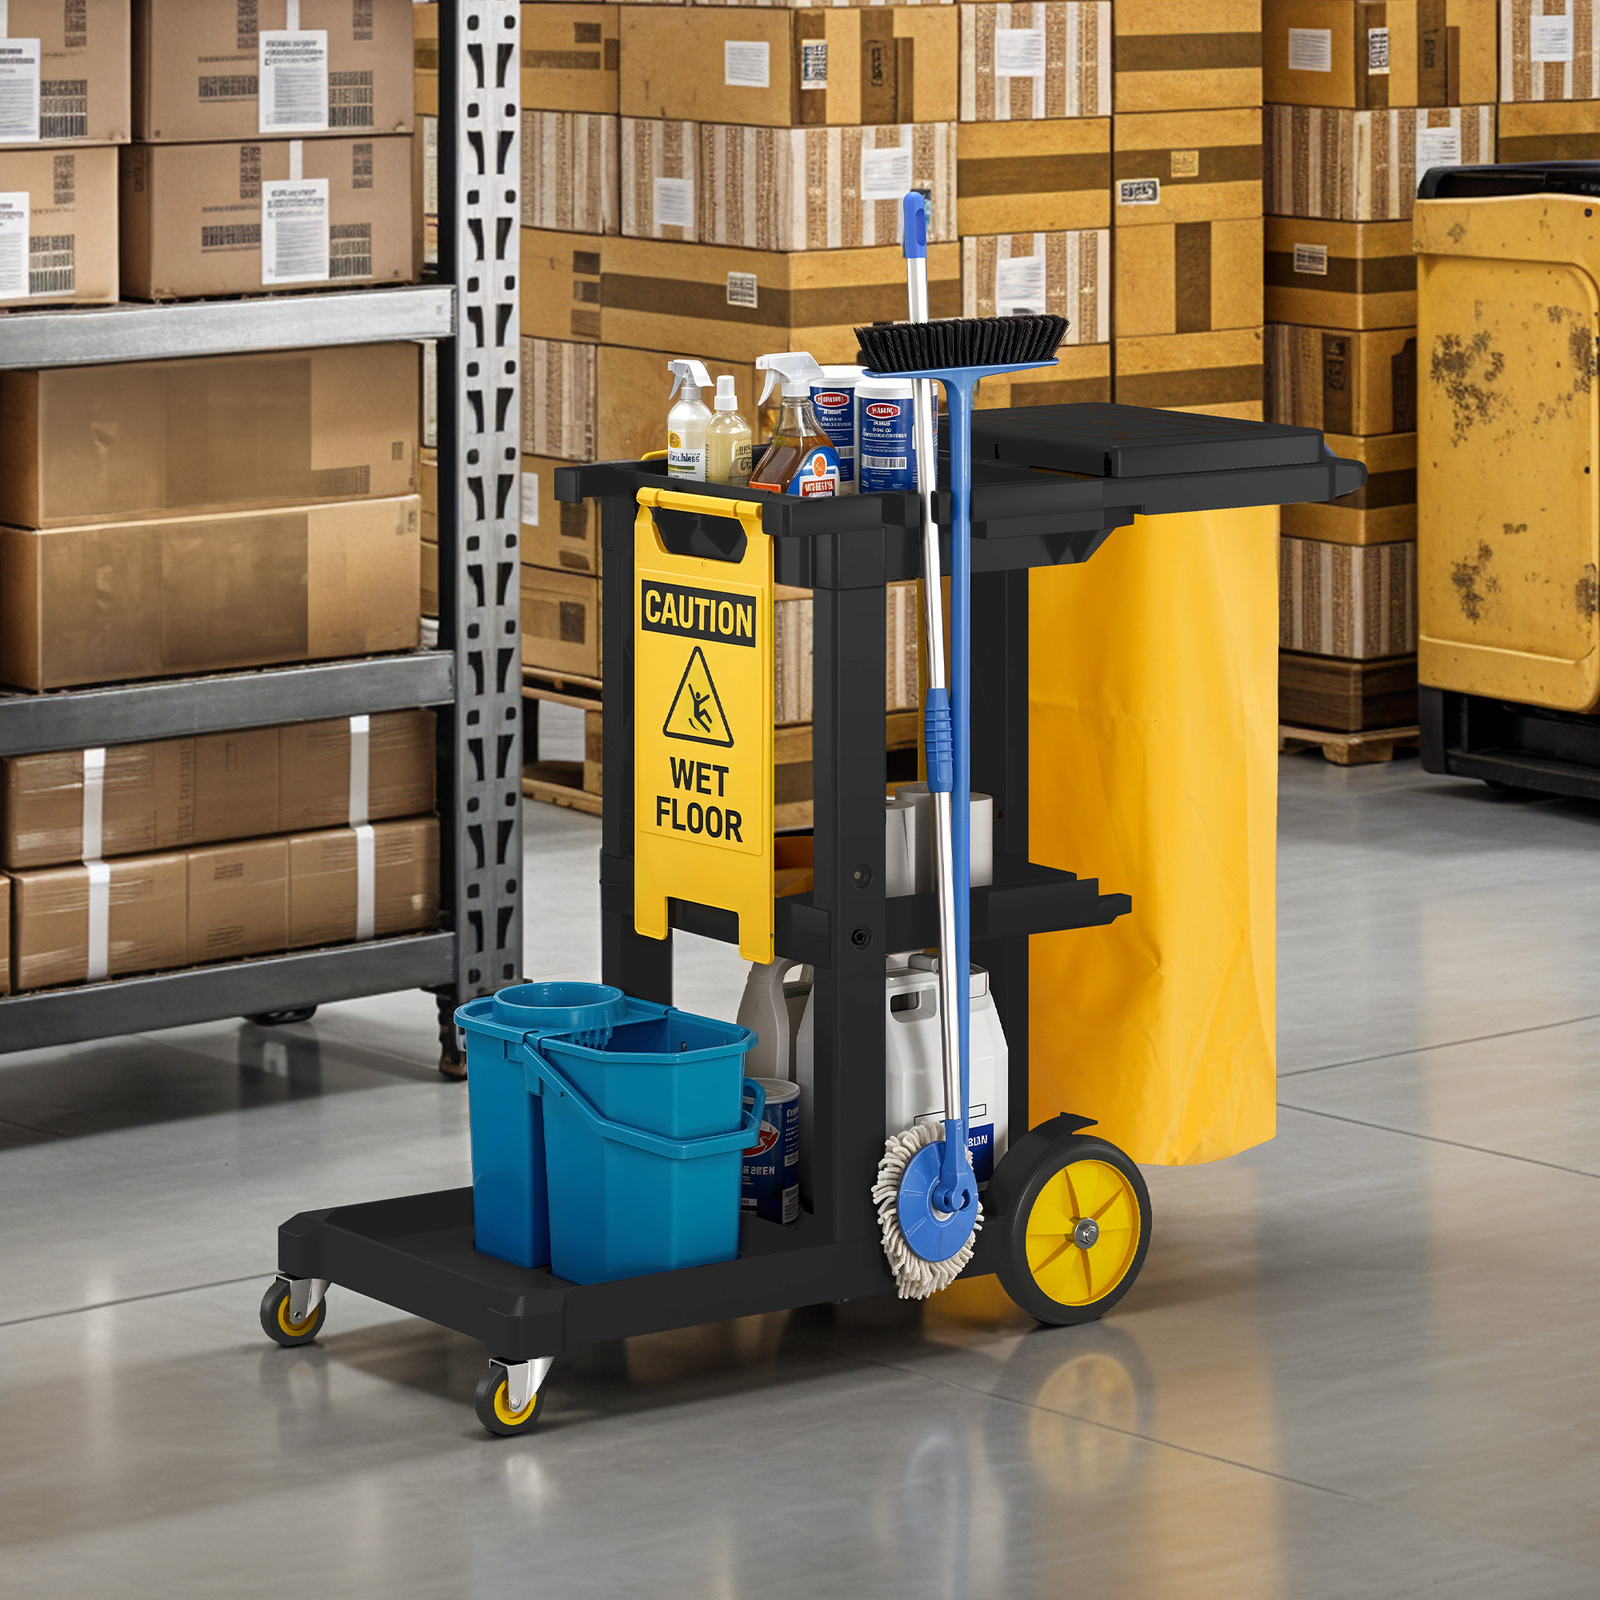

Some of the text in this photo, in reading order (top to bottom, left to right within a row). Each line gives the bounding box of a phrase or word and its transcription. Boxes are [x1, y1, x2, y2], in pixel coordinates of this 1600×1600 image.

[645, 589, 753, 638] CAUTION
[669, 756, 729, 797] WET
[656, 795, 743, 843] FLOOR
